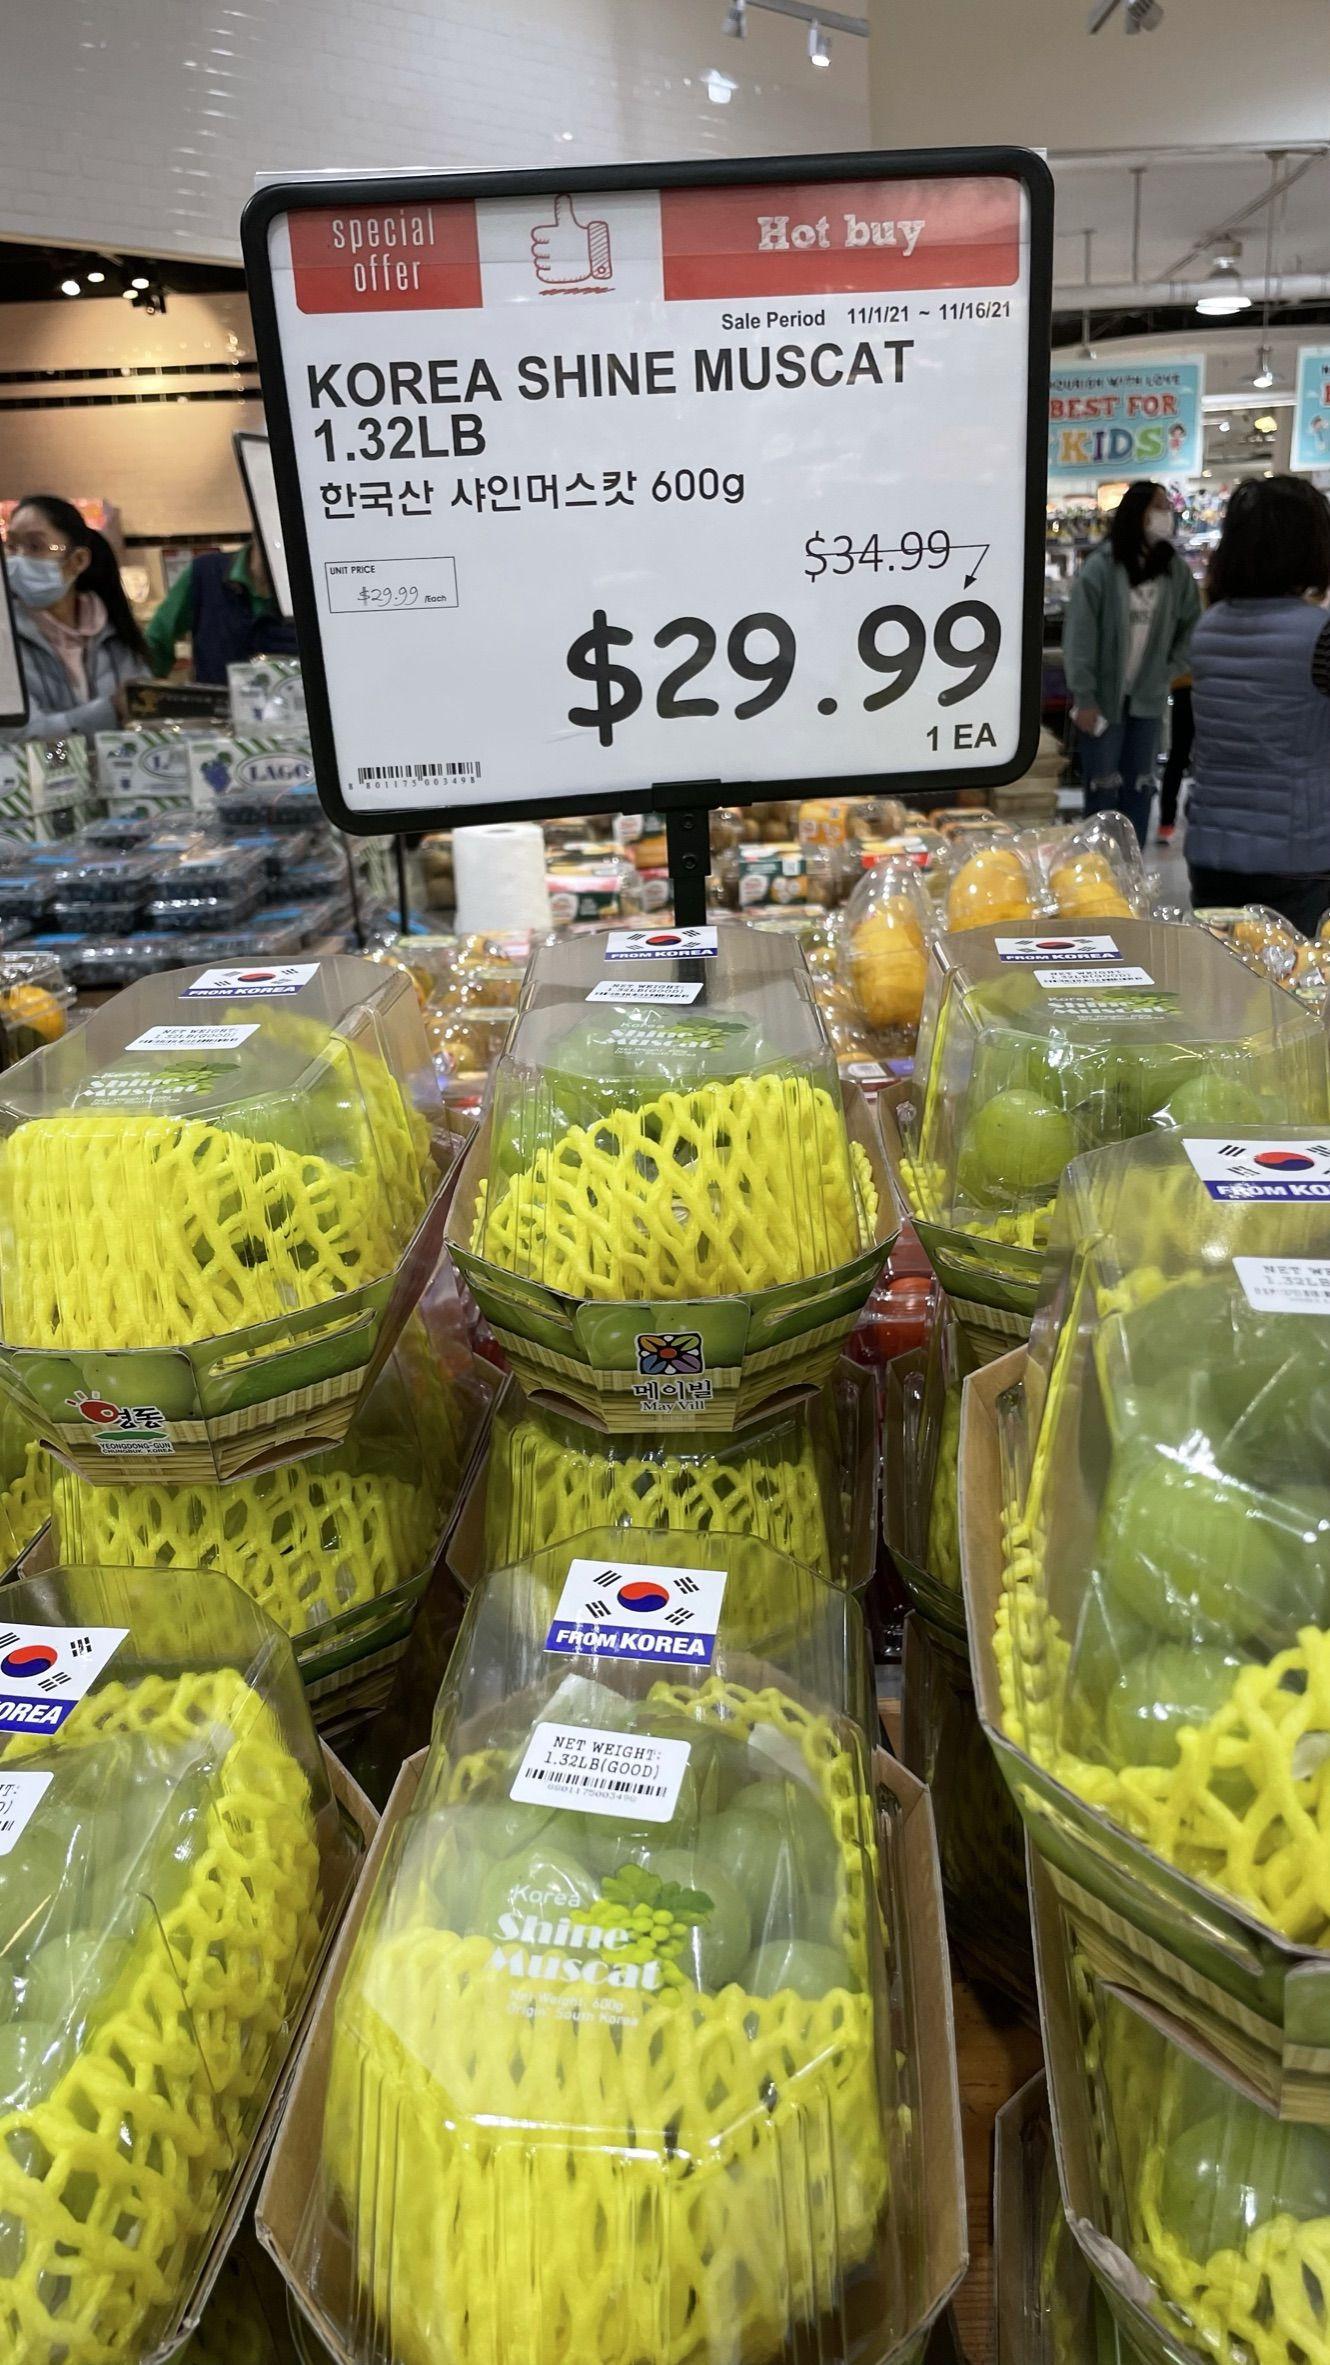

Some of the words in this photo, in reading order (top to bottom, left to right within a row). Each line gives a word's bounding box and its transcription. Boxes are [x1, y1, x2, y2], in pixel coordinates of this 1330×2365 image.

[333, 208, 434, 249] special
[757, 214, 831, 253] Hot
[845, 212, 926, 257] buy
[353, 255, 423, 294] offer
[721, 310, 760, 331] Sale
[765, 307, 826, 330] Period
[847, 304, 909, 325] 11/1/21
[938, 301, 1011, 322] 11/16/21
[307, 357, 502, 408] KOREA
[518, 350, 677, 398] SHINE
[693, 340, 914, 393] MUSCAT
[1050, 396, 1120, 420] BEST
[1127, 393, 1178, 417] FOR
[313, 413, 486, 463] 1.32LB
[1061, 426, 1164, 463] KIDS
[319, 480, 434, 520] 한국산
[451, 469, 638, 515] 샤인머스캇
[650, 468, 747, 507] 600g
[330, 566, 348, 575] UNIT
[351, 564, 376, 575] PRICE
[803, 529, 952, 584] $34.99
[357, 586, 419, 607] $29.99
[566, 599, 1003, 748] $29.99
[925, 726, 937, 752] 1
[953, 722, 998, 751] EA
[655, 948, 713, 958] KOREA
[1051, 952, 1115, 960] KOREA
[188, 988, 233, 997] FROM
[234, 985, 298, 996] KOREA
[1216, 1184, 1288, 1196] FROM
[634, 1380, 711, 1400] 메이빌
[643, 1401, 675, 1413] May
[678, 1400, 705, 1411] Vill
[555, 1629, 617, 1650] FROM
[619, 1632, 706, 1657] KOREA
[553, 1736, 586, 1751] NET
[592, 1739, 663, 1762] WEIGHT:
[544, 1751, 661, 1779] 1.32LB(GOOD)
[510, 1884, 581, 1908] Korea
[494, 1913, 630, 1951] Shine
[485, 1946, 664, 1991] Muscat
